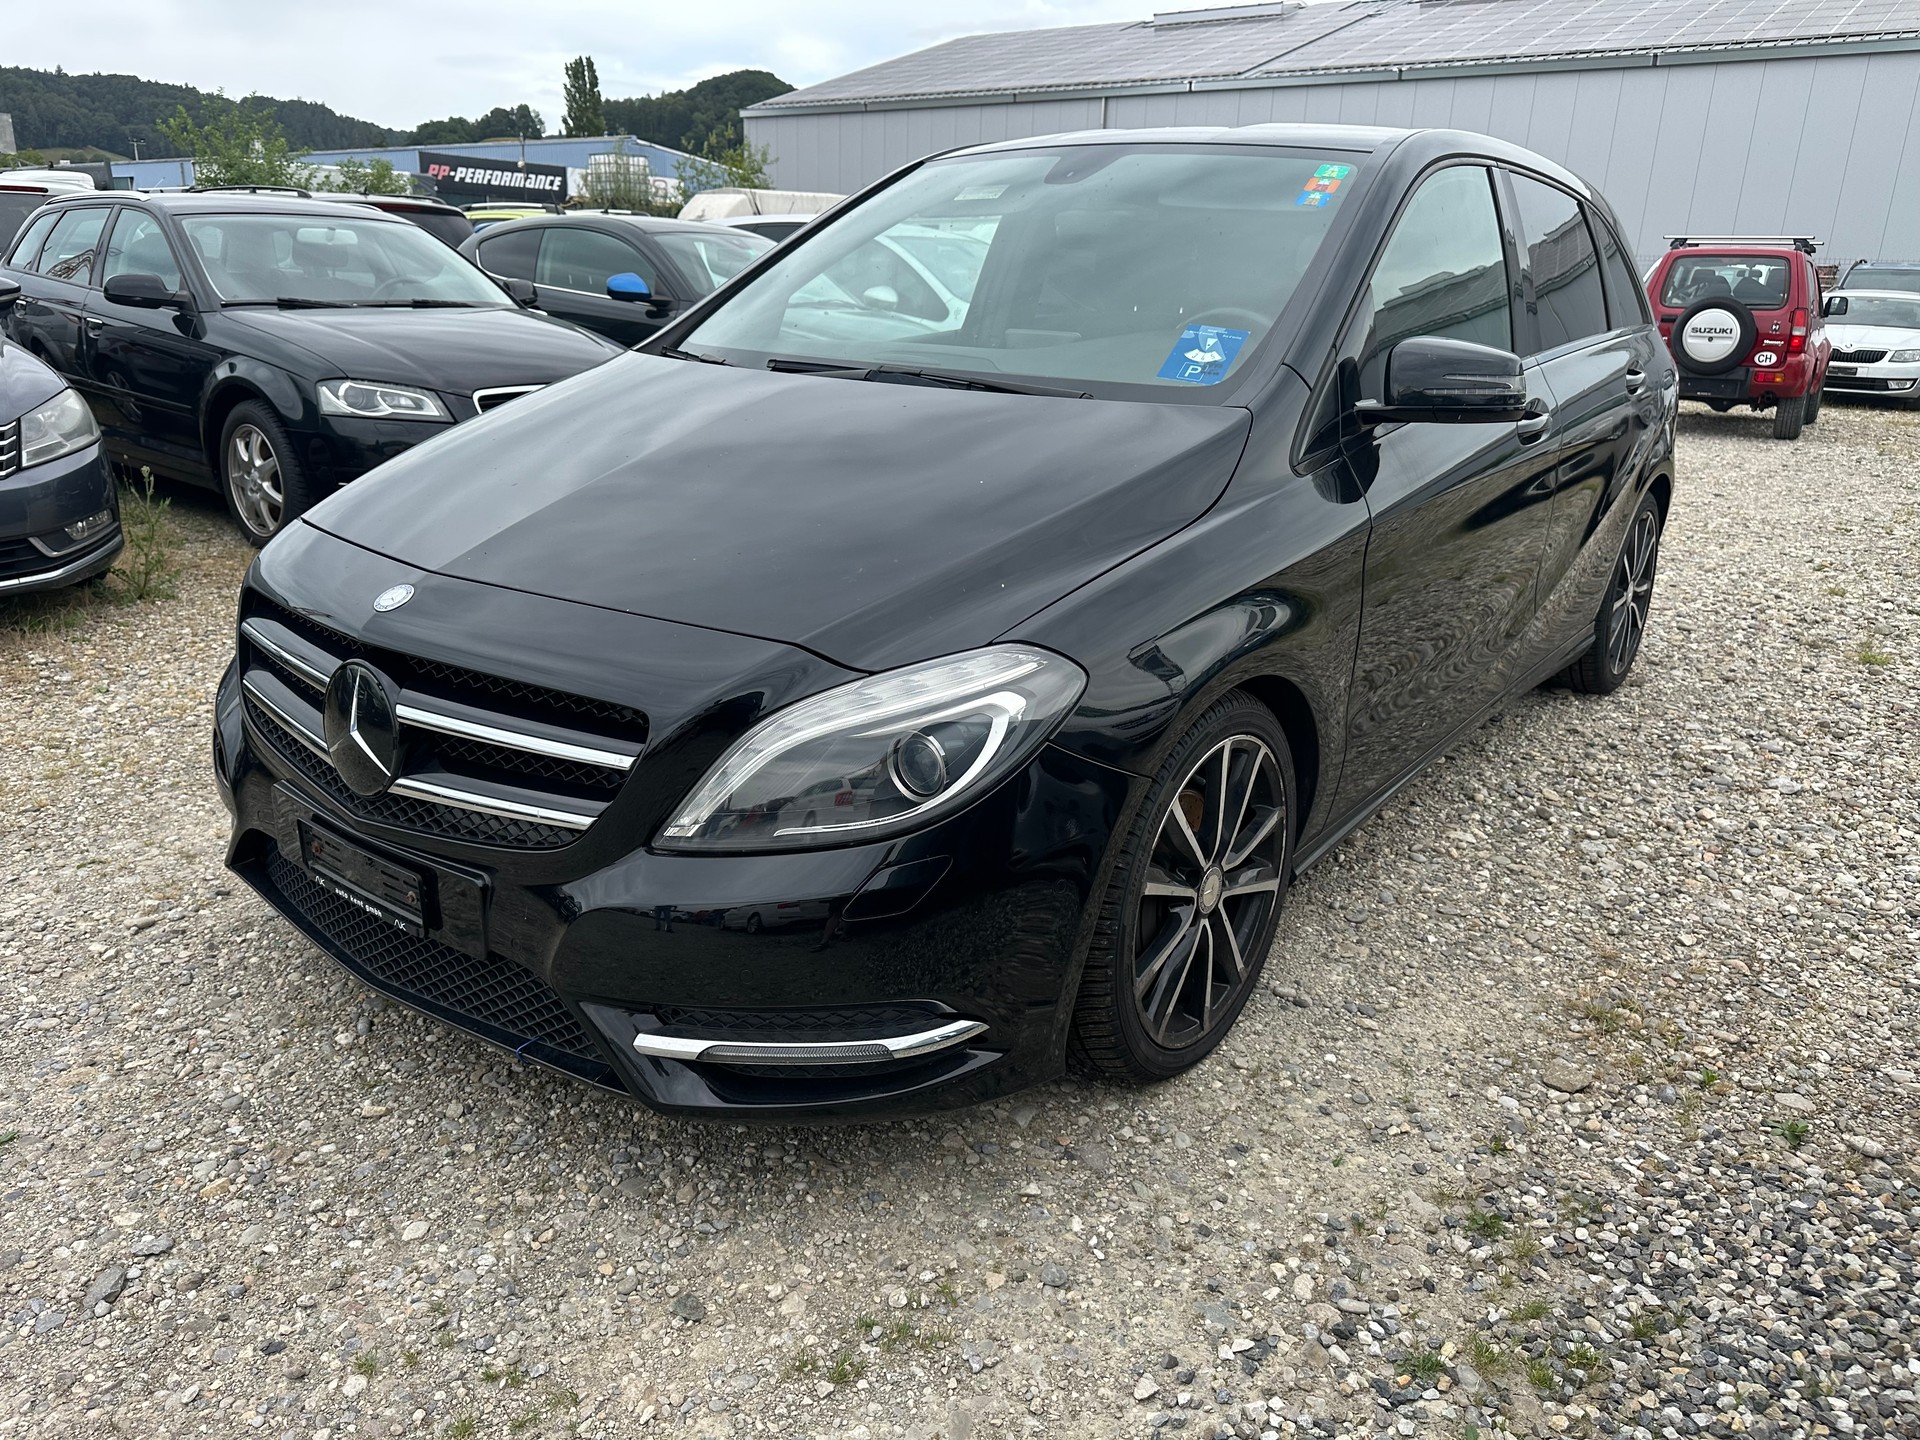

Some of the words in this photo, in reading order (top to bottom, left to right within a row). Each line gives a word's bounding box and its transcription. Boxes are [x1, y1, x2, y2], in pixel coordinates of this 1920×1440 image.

[428, 163, 562, 191] PP-PERFORMANCE
[1691, 327, 1733, 335] SUZUKI
[1757, 354, 1773, 363] CH
[1184, 365, 1202, 377] P
[335, 887, 349, 899] auto
